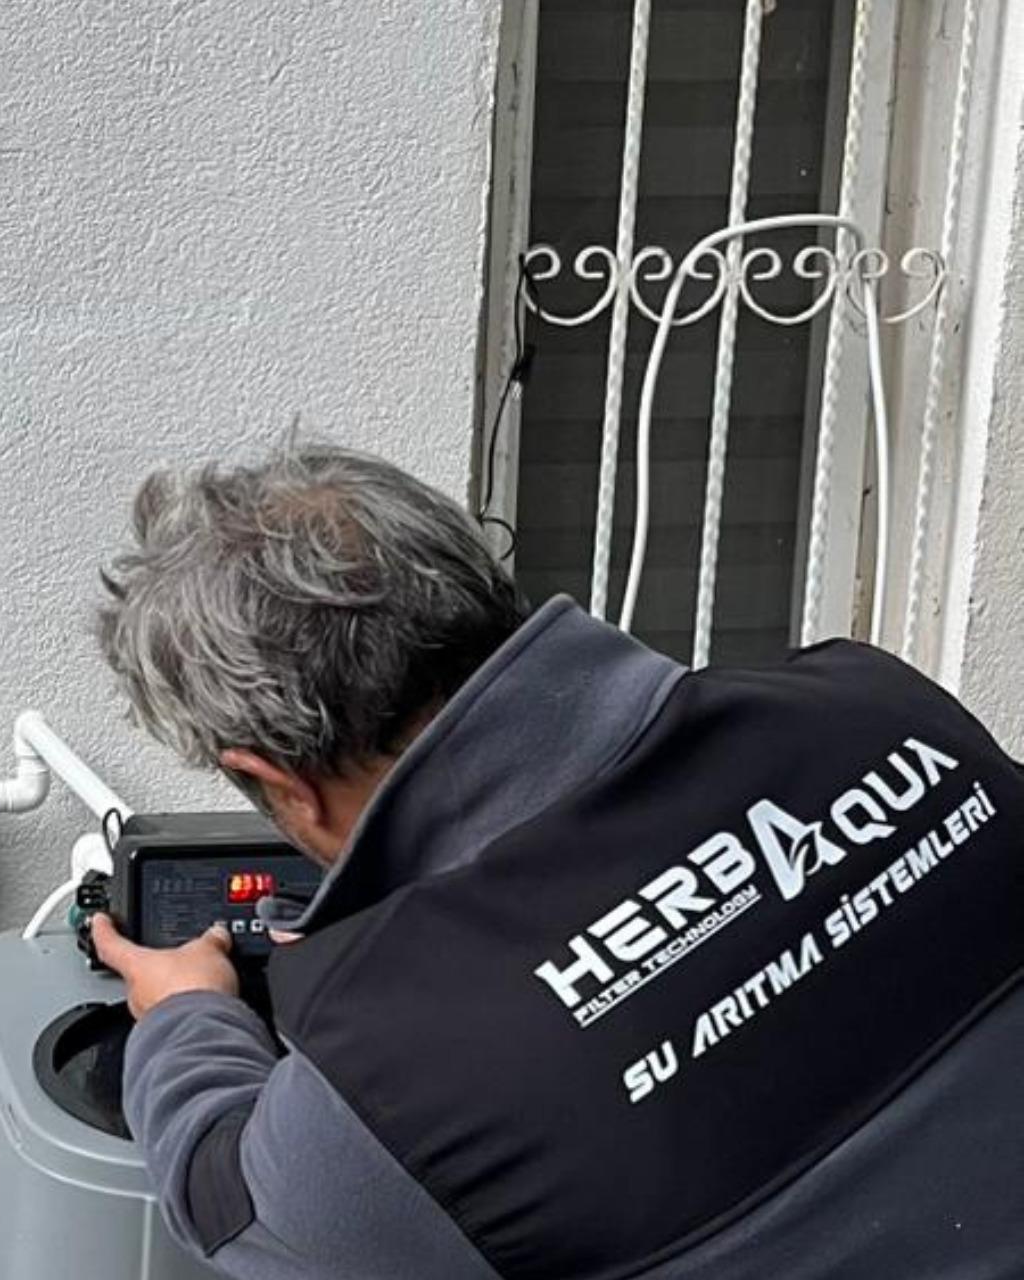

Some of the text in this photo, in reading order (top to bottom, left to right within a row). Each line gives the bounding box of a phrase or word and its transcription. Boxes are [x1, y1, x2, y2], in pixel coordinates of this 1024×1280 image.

[573, 884, 758, 1023] FILTER TECHNOLOGY
[622, 781, 998, 1103] SU ARITMA SİSTEMLERİ
